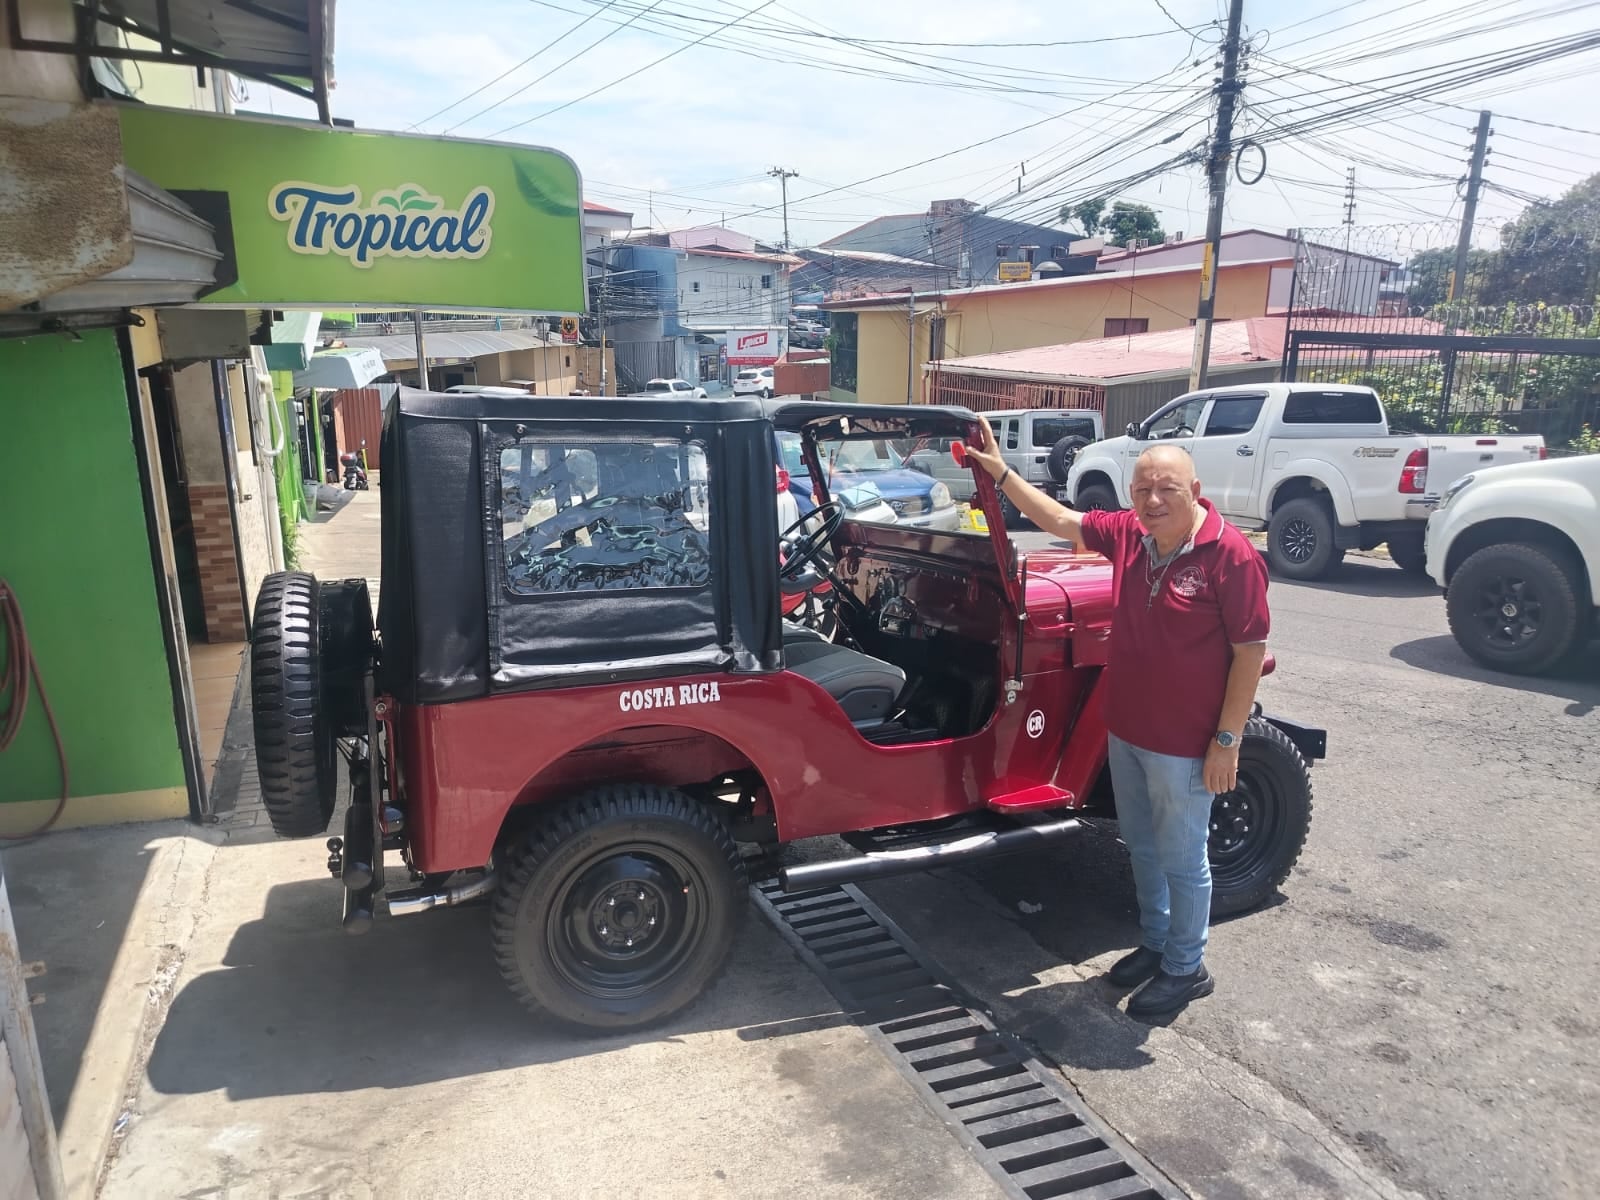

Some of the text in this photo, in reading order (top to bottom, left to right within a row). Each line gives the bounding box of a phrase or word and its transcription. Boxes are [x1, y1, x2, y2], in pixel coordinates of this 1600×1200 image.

[275, 187, 490, 263] Tropical
[620, 681, 720, 711] COSTA RICA
